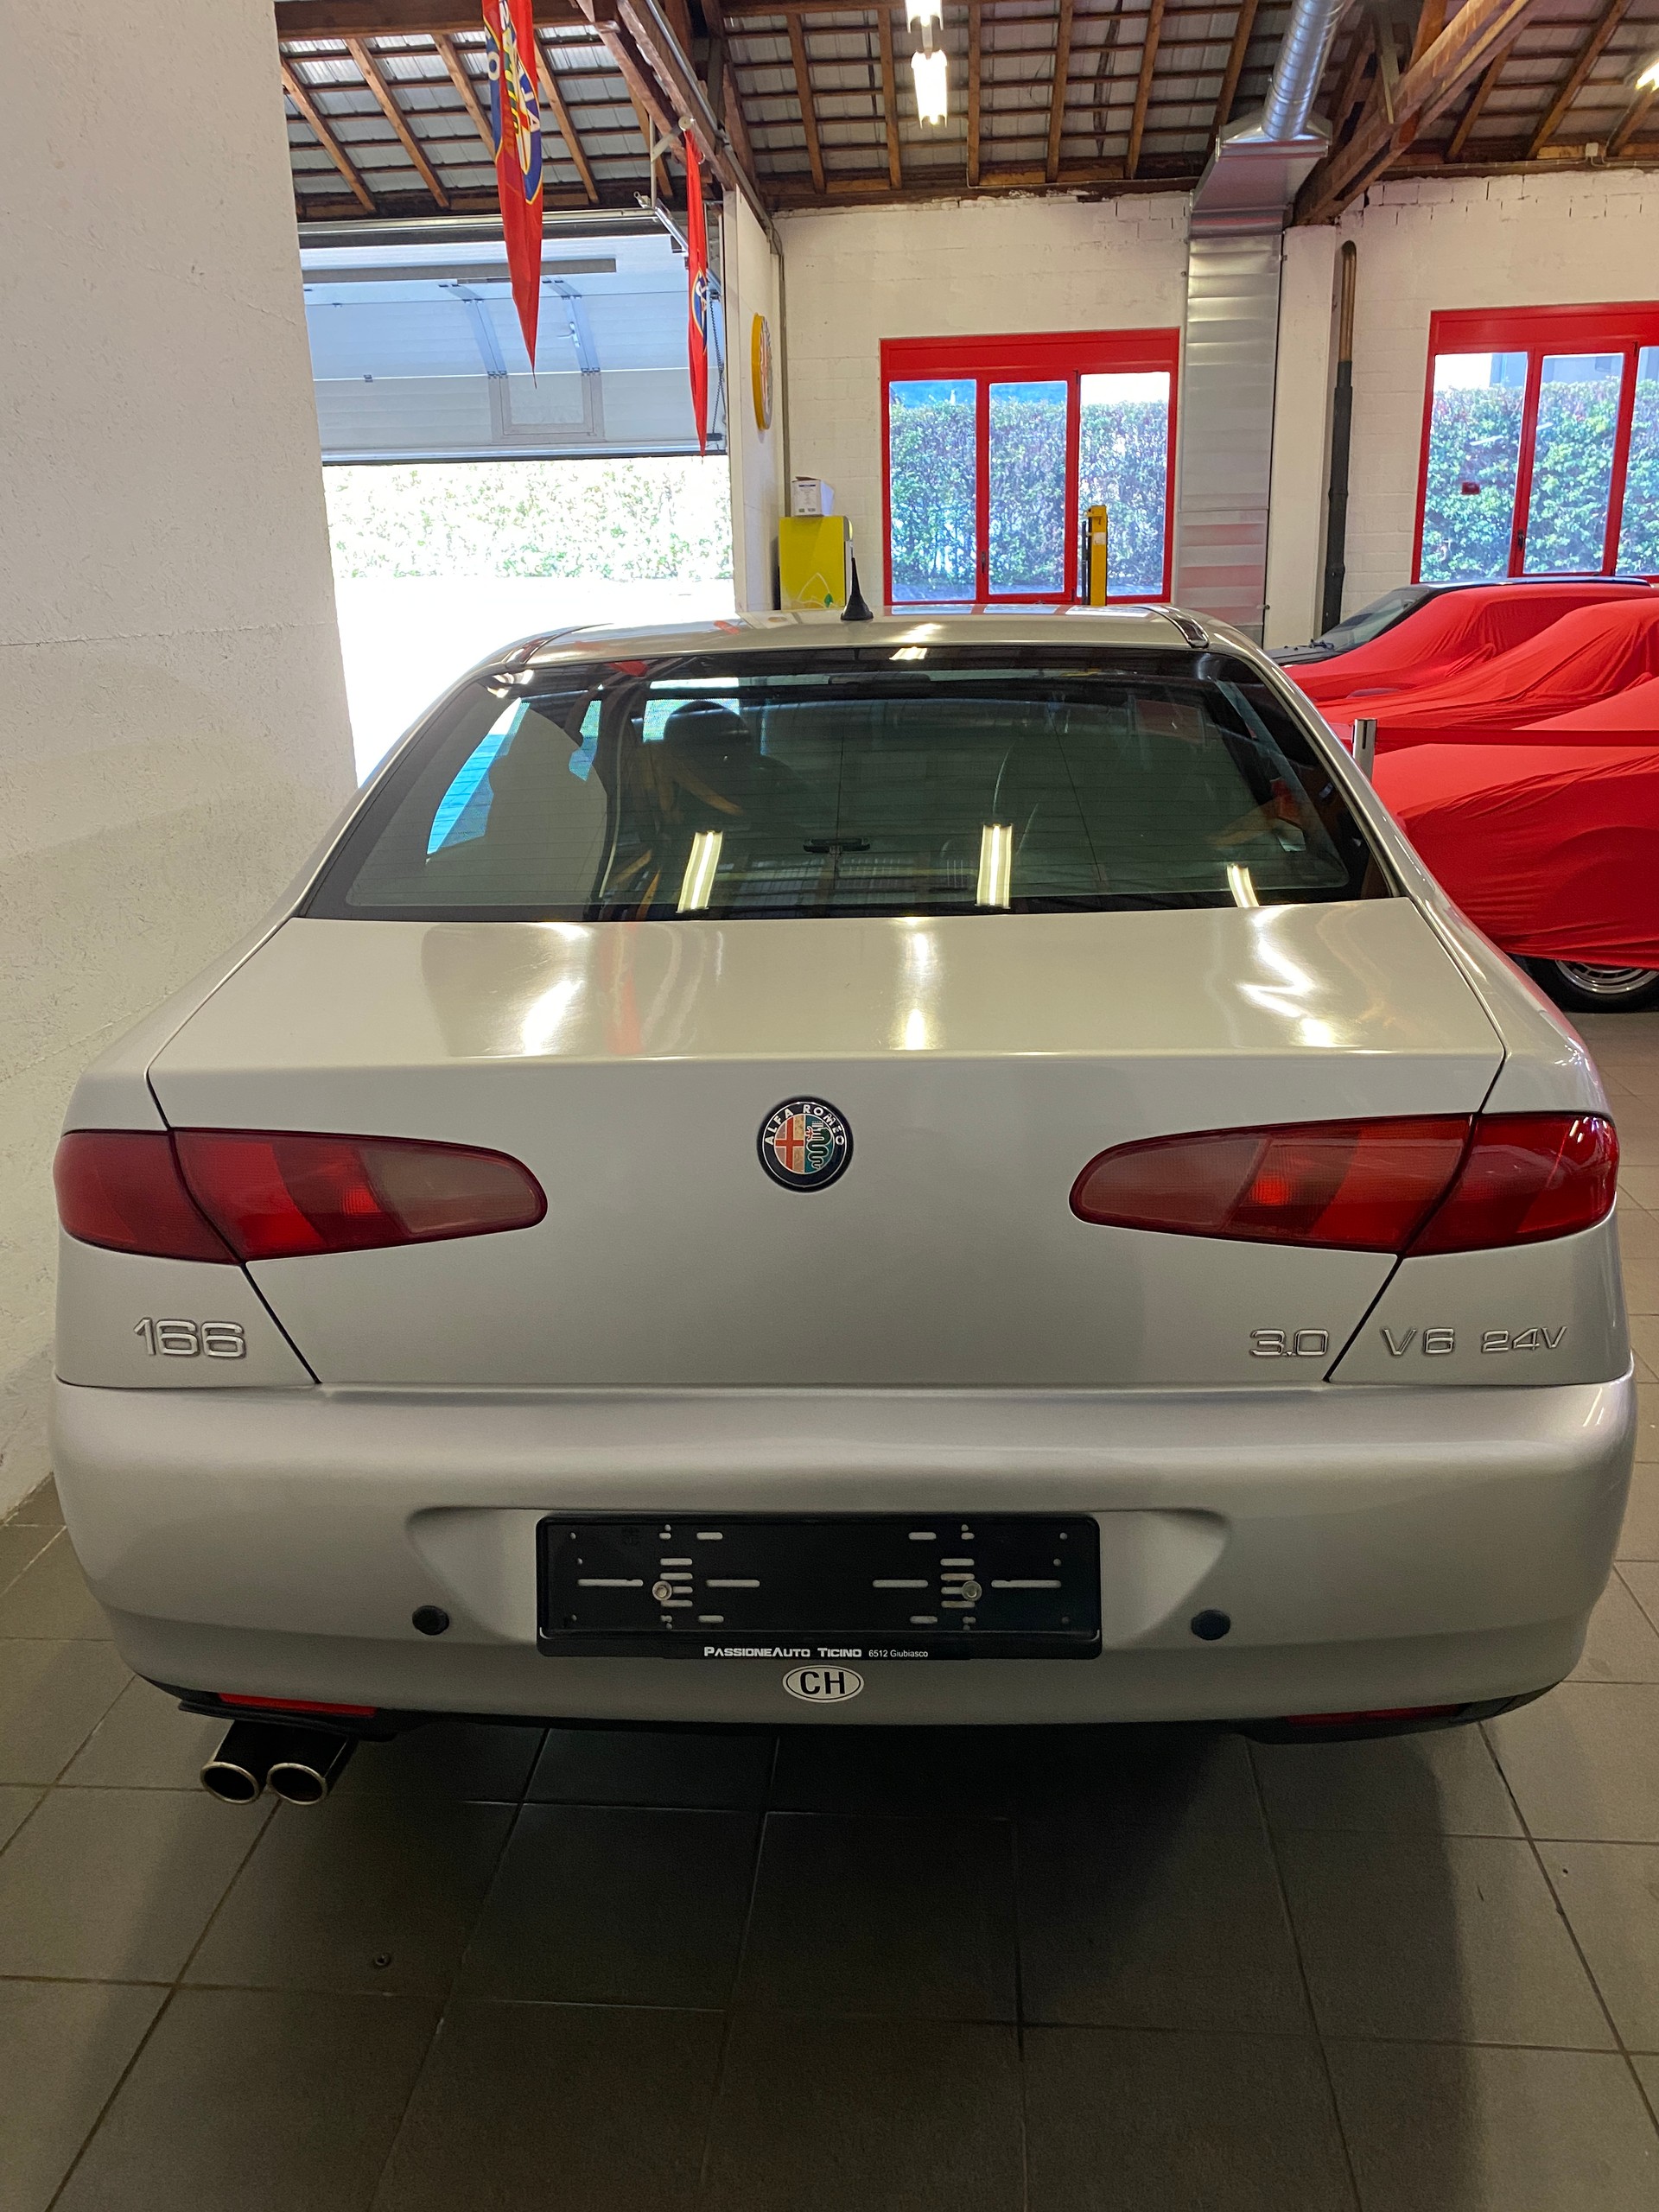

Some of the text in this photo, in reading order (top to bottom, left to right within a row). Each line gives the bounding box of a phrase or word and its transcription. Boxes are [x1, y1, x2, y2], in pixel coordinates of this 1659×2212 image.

[765, 1104, 844, 1146] ALFA ROMEO
[133, 1317, 246, 1359] 166
[1250, 1326, 1567, 1357] 3.0 V6 24V
[817, 1647, 862, 1657] TICINO
[868, 1649, 888, 1657] 6512
[889, 1649, 929, 1658] Giubiasco
[799, 1670, 847, 1695] CH
